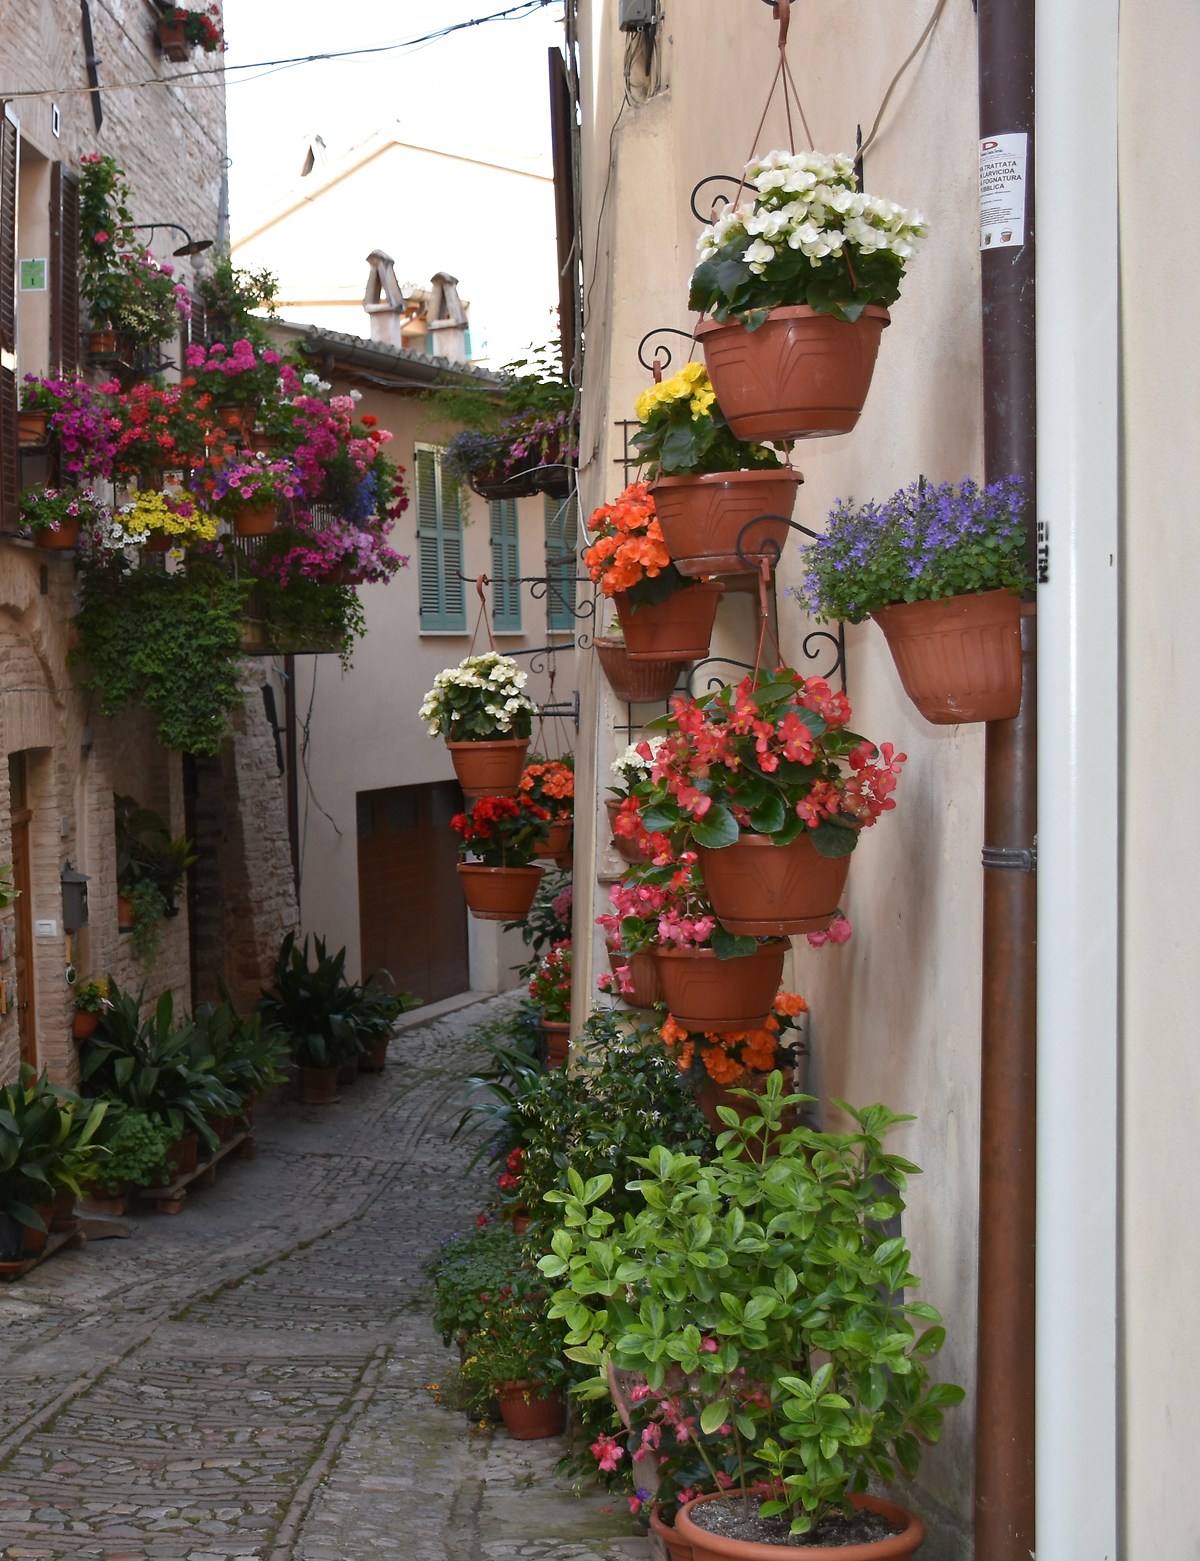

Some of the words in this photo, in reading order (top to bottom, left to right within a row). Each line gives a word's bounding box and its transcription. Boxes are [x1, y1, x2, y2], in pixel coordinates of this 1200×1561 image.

[985, 160, 1017, 170] TRATTATA
[983, 168, 1015, 178] LARVICIDA
[983, 175, 1022, 185] FOGNATURA
